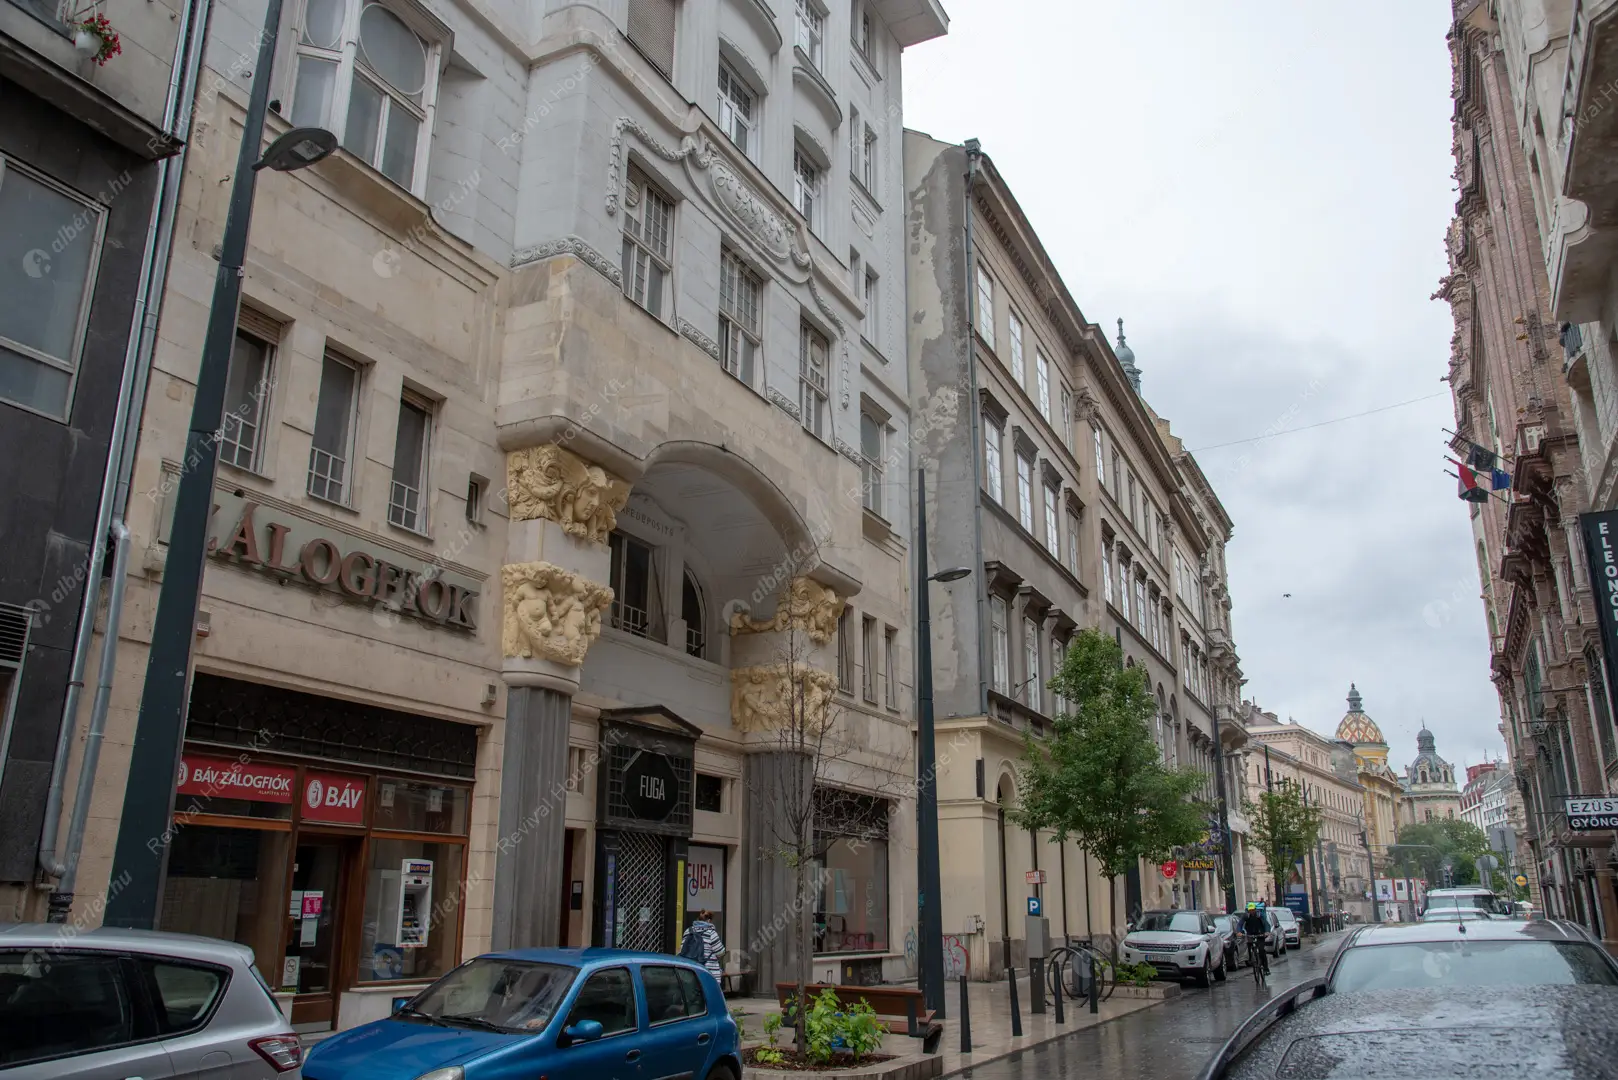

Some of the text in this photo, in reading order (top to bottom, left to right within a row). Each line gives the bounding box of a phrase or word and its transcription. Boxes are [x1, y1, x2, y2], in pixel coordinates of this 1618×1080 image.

[1598, 522, 1618, 637] ELEONÓ
[193, 767, 291, 791] BÁV ZÁLOGFIÓK
[640, 775, 665, 800] FUGA
[325, 783, 362, 809] BÁV
[1571, 799, 1618, 813] EZÜS
[1184, 860, 1214, 869] CHANGE
[1029, 900, 1038, 912] P
